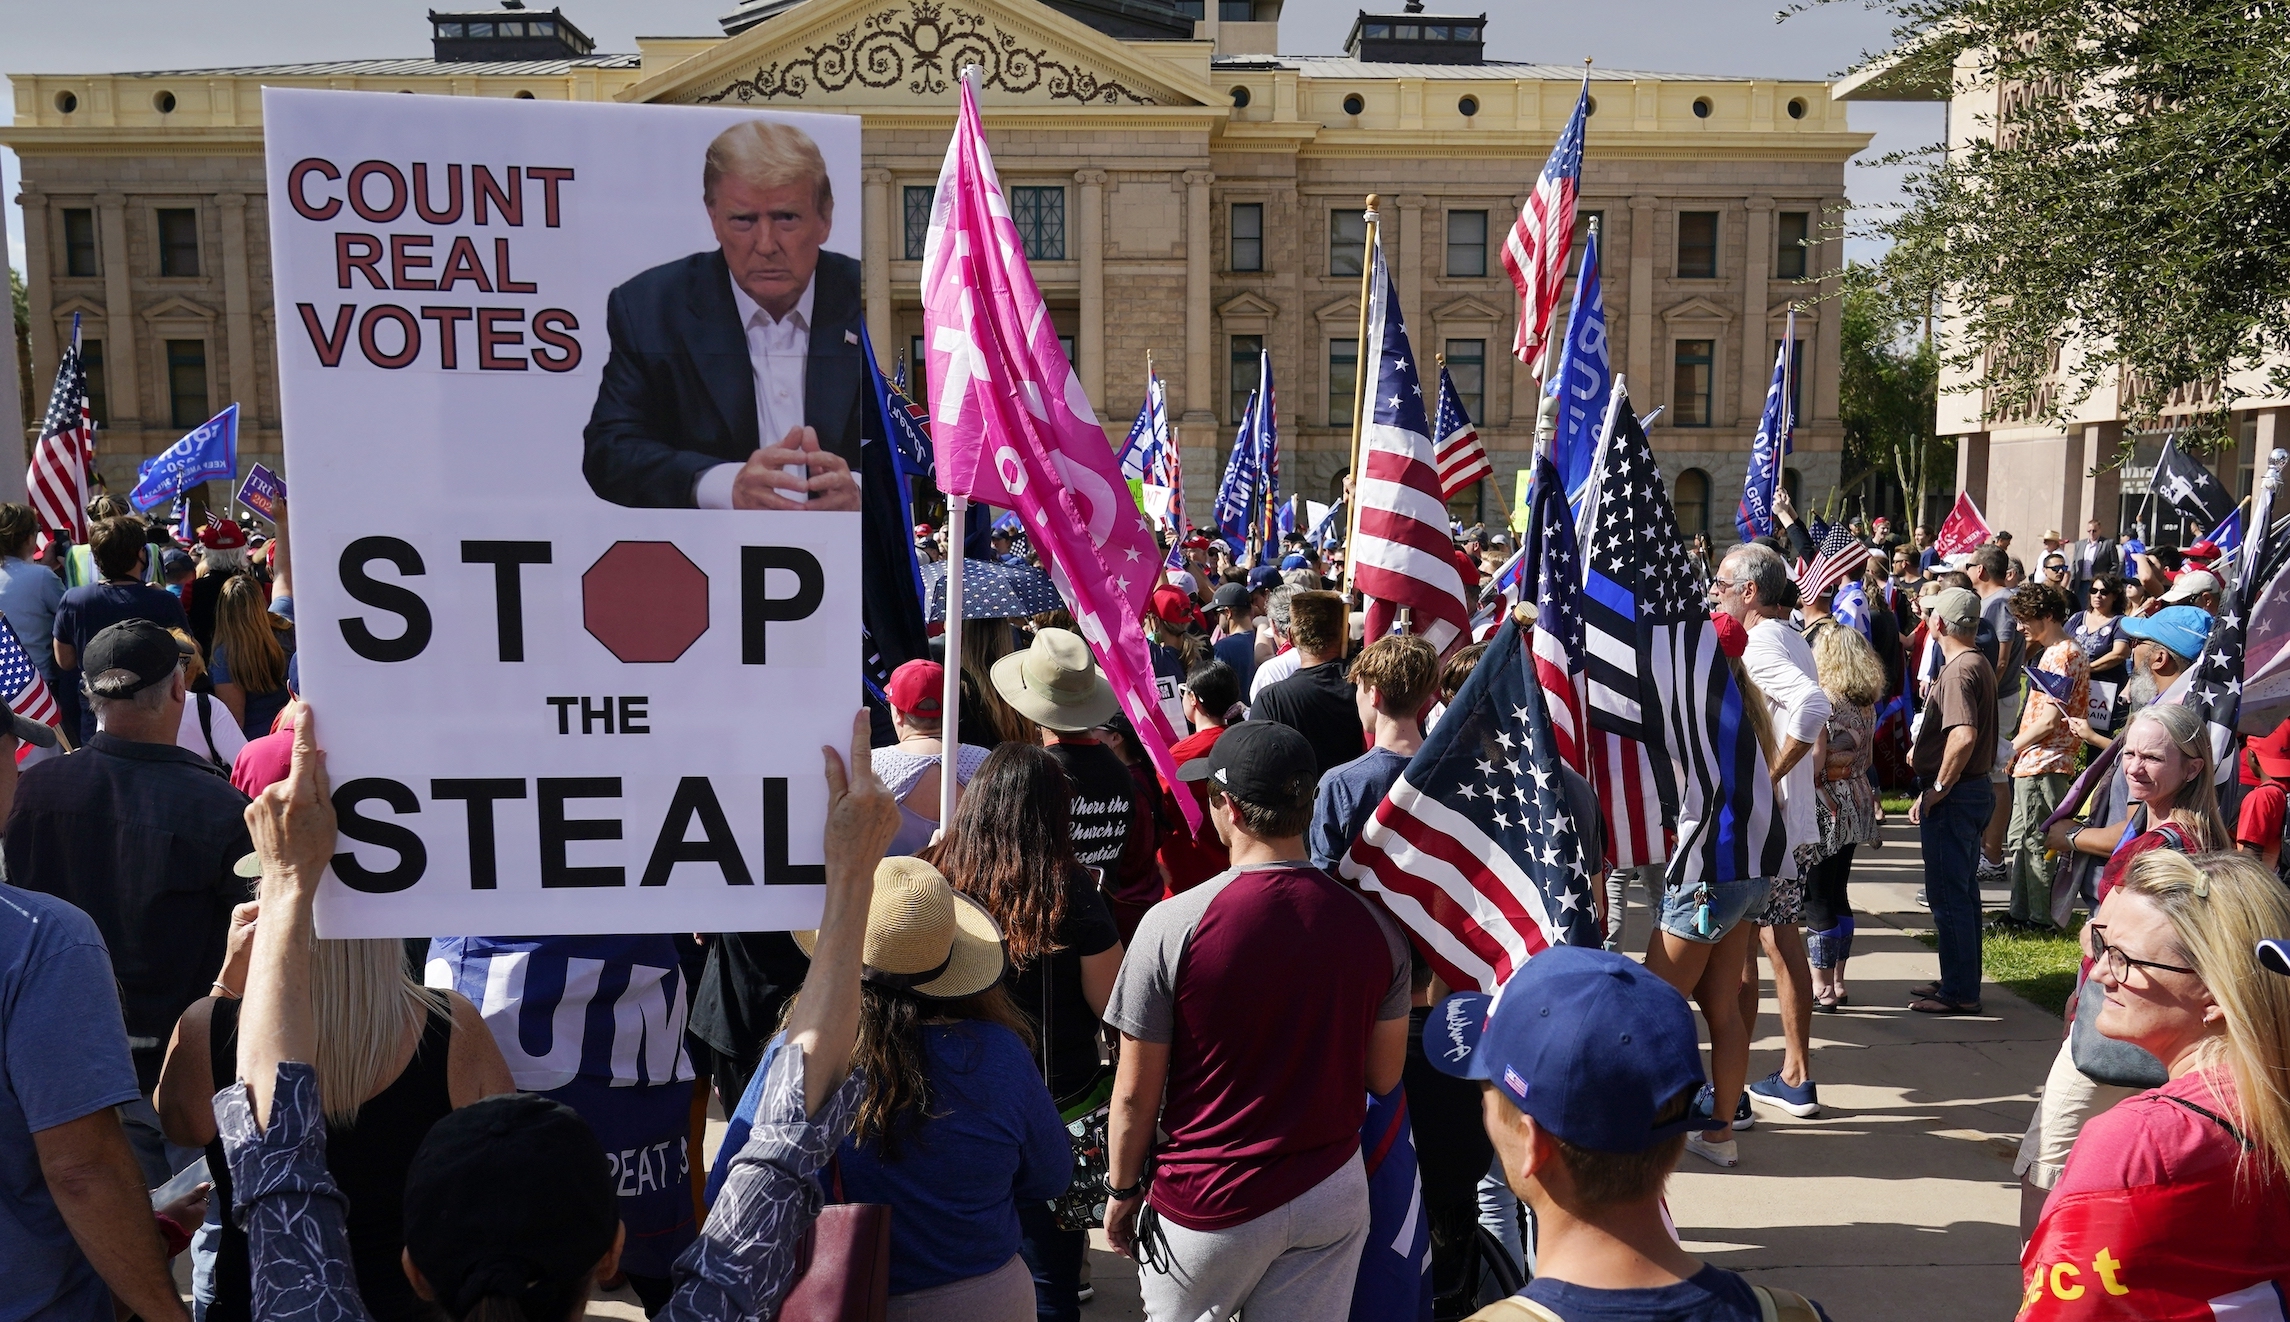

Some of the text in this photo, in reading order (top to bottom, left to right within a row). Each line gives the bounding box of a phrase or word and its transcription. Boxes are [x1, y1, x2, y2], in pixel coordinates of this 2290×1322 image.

[288, 157, 575, 228] COUNT
[335, 232, 538, 294] REAL
[296, 303, 583, 373] VOTES
[250, 474, 275, 499] TRU
[252, 494, 272, 512] 202
[546, 696, 651, 735] THE
[1107, 796, 1129, 813] the
[330, 777, 826, 894] STEAL
[1114, 820, 1127, 837] is
